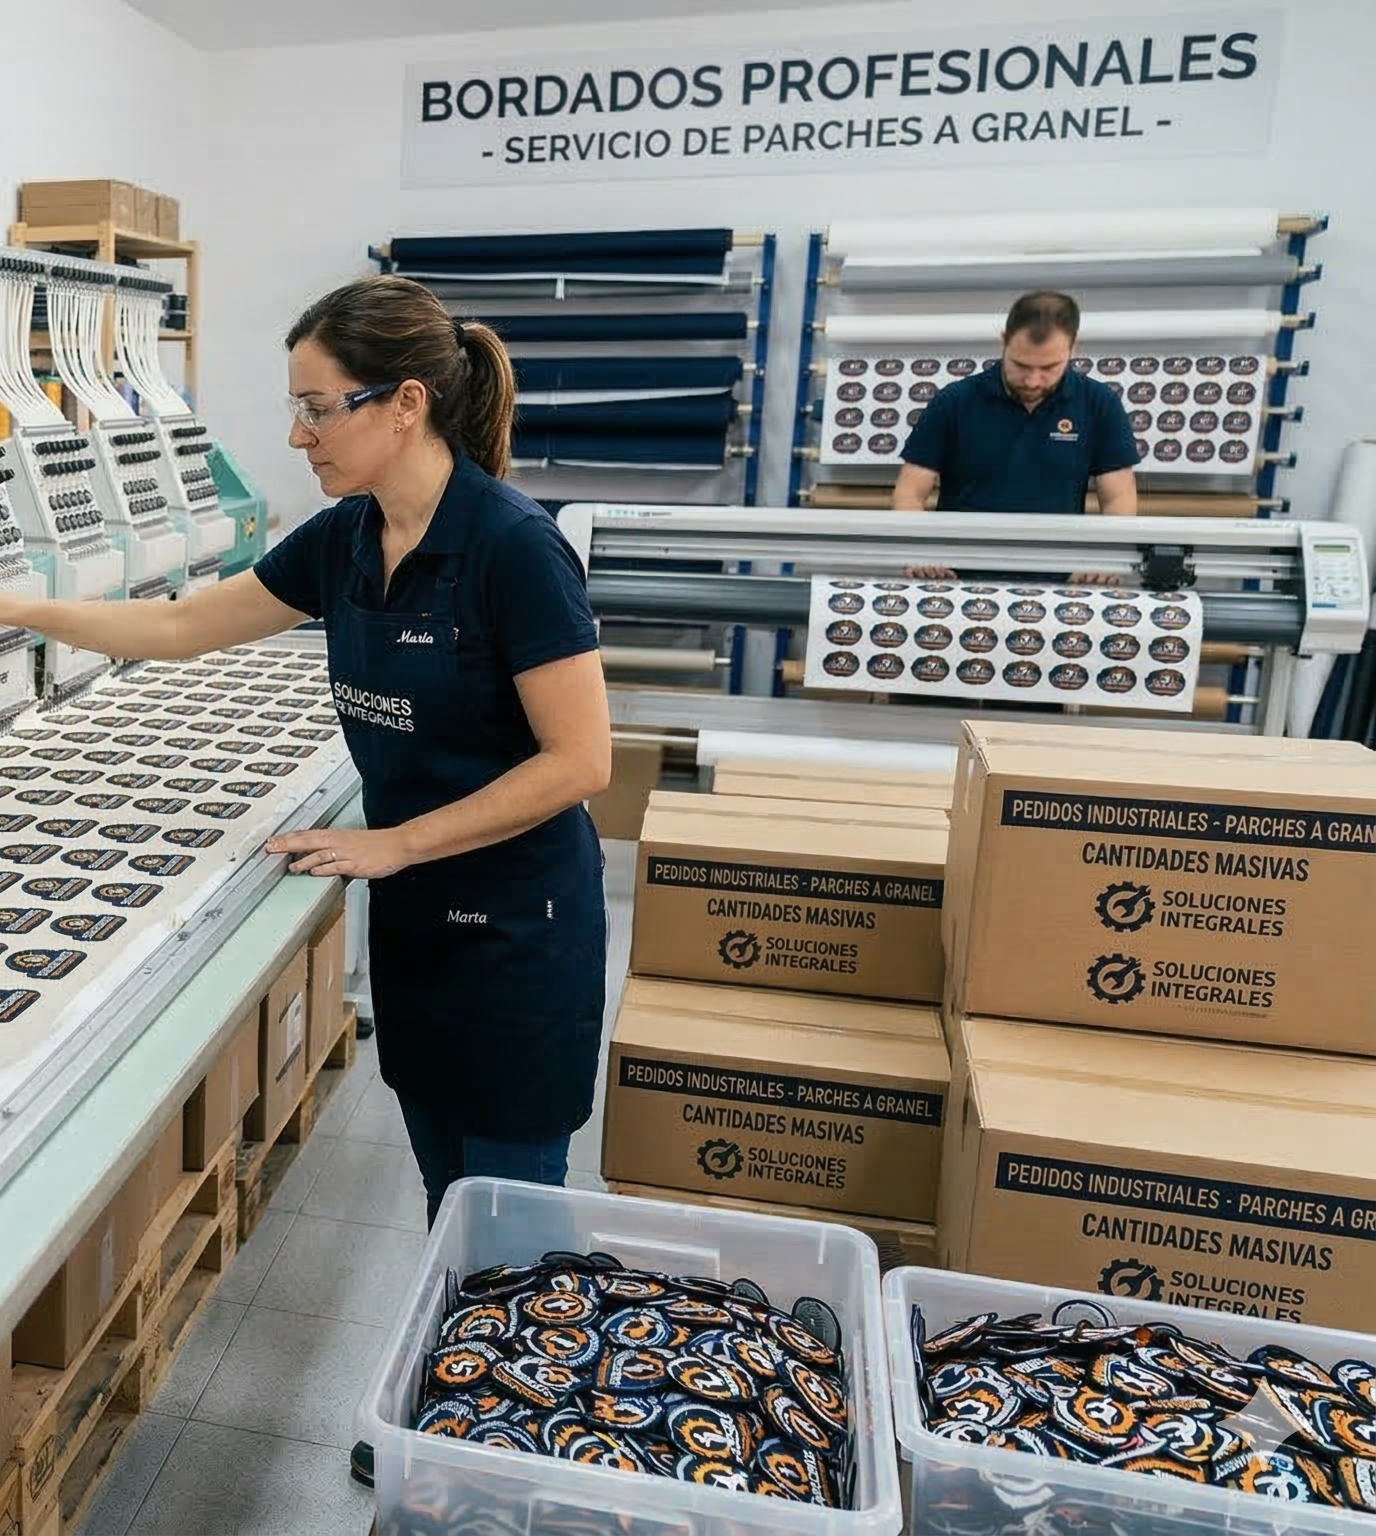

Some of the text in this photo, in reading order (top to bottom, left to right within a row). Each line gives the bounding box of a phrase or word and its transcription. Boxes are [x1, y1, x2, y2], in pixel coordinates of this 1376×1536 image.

[422, 31, 1259, 123] BORDADOS PROFESIONALES
[504, 129, 672, 165] SERVICIO
[683, 125, 731, 156] DE
[743, 116, 923, 154] PARCHES
[933, 114, 961, 145] A
[972, 105, 1144, 143] GRANEL
[334, 681, 412, 716] SOLUCIONES
[1012, 799, 1083, 824] PEDIDOS
[1087, 805, 1209, 832] INDUSTRIALES
[1225, 815, 1306, 839] PARCHES
[1310, 820, 1323, 841] A
[1081, 842, 1310, 883] CANTIDADES MASIVAS
[655, 863, 707, 882] PEDIDOS
[709, 868, 800, 891] INDUSTRIALES
[810, 876, 870, 897] PARCHES
[872, 881, 882, 897] A
[885, 882, 937, 902] GRANEL
[447, 909, 488, 924] Marta
[707, 898, 877, 930] CANTIDADES MASIVAS
[1162, 889, 1287, 916] SOLUCIONES
[1160, 910, 1285, 938] INTEGRALES
[765, 936, 859, 958] SOLUCIONES
[765, 953, 858, 974] INTEGRALES
[1152, 960, 1277, 988] SOLUCIONES
[1150, 981, 1274, 1008] INTEGRALES
[627, 1064, 684, 1088] PEDIDOS
[687, 1070, 785, 1099] INDUSTRIALES
[797, 1085, 861, 1109] PARCHES
[863, 1091, 874, 1110] A
[876, 1094, 933, 1118] GRANEL
[682, 1103, 864, 1145] CANTIDADES MASIVAS
[747, 1147, 847, 1173] SOLUCIONES
[747, 1163, 846, 1189] INTEGRALES
[1008, 1161, 1083, 1191] PEDIDOS
[1088, 1173, 1220, 1209] INDUSTRIALES
[1238, 1193, 1327, 1225] PARCHES
[1330, 1206, 1344, 1227] A
[1081, 1212, 1334, 1271] CANTIDADES MASIVAS
[1169, 1270, 1306, 1305] SOLUCIONES
[1168, 1292, 1302, 1324] INTEGRALES
